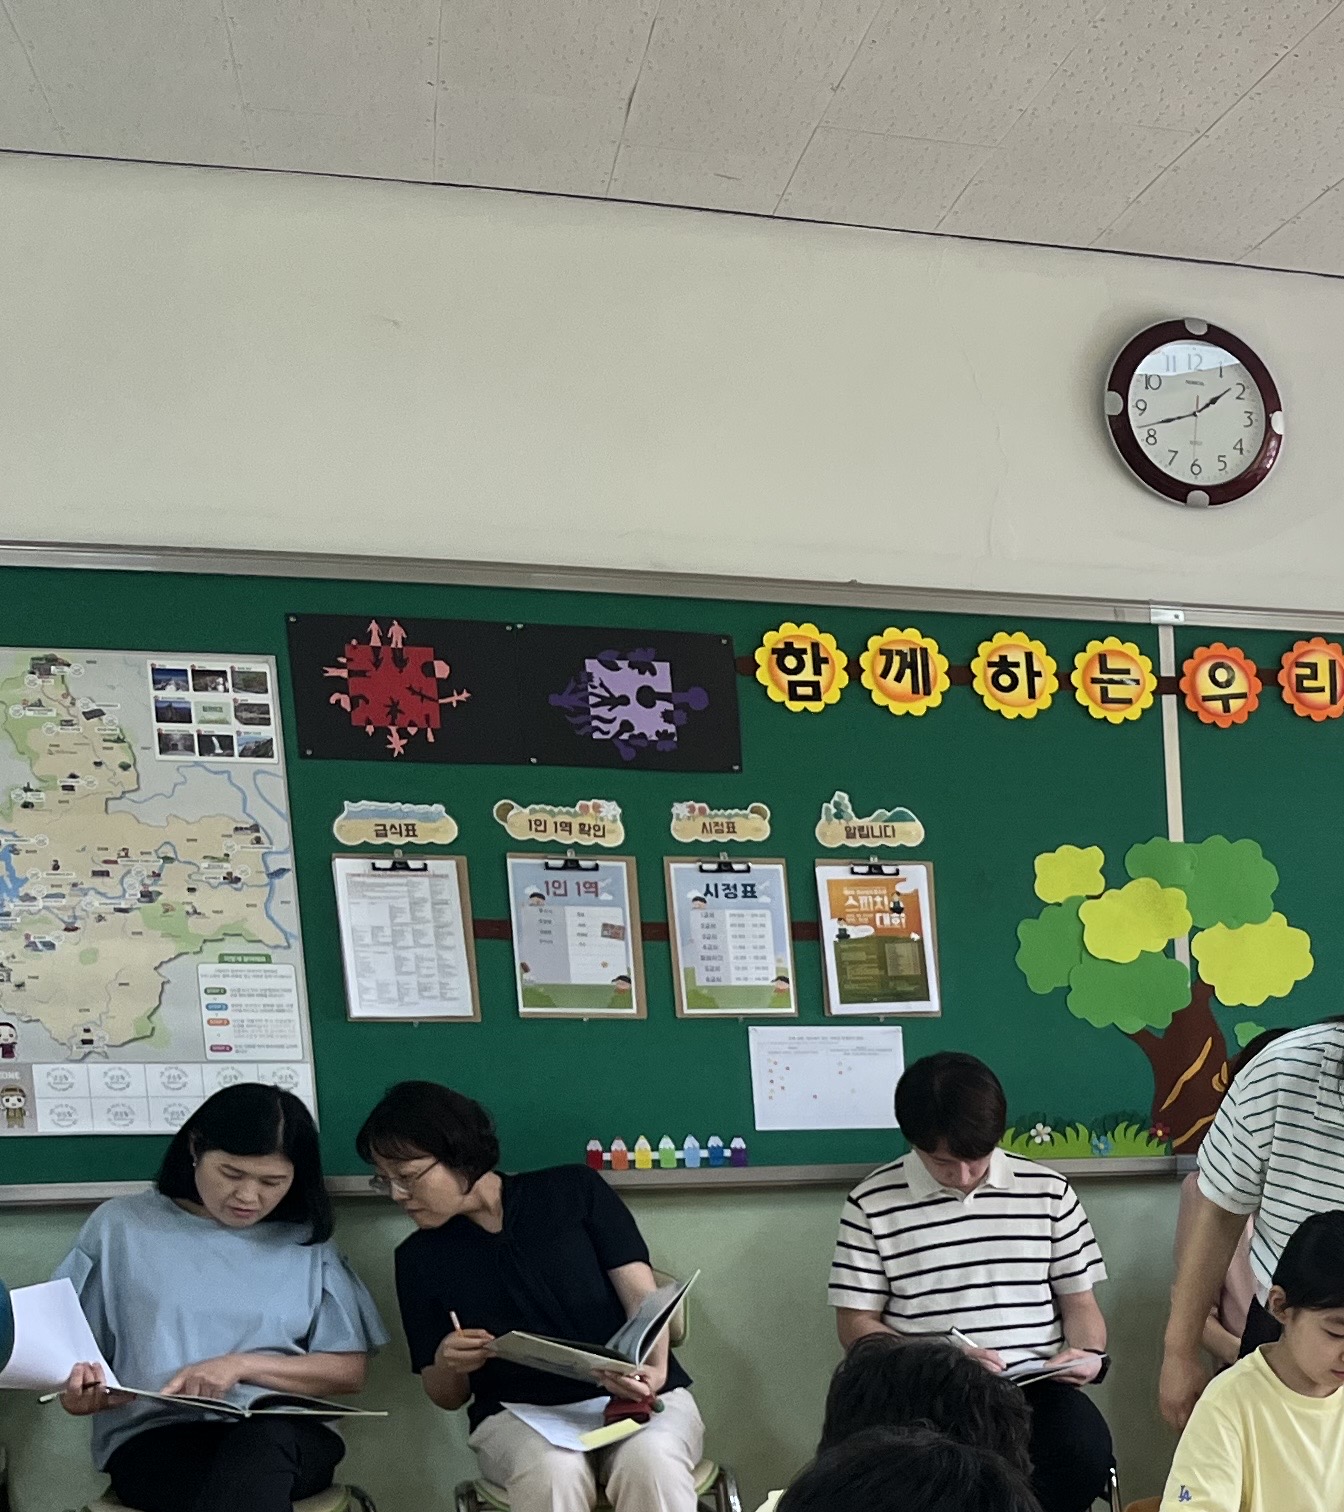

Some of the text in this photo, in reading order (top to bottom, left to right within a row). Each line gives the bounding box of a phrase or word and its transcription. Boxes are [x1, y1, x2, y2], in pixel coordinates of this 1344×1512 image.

[1165, 355, 1177, 373] 11
[1187, 353, 1203, 372] 12
[1218, 361, 1224, 379] 1
[1143, 374, 1162, 391] 10
[1235, 382, 1246, 401] 2
[1135, 399, 1147, 416] 9
[1243, 411, 1254, 428] 3
[1145, 428, 1157, 446] 8
[1233, 438, 1244, 455] 4
[1167, 449, 1178, 467] 7
[1190, 458, 1202, 476] 6
[1217, 454, 1227, 472] 5
[771, 640, 1338, 714] 함께하는 우리
[374, 822, 418, 838] 급식표
[528, 818, 606, 838] 1인 1역 확인
[701, 821, 737, 835] 시정표
[844, 825, 896, 839] 알립니다
[544, 879, 599, 898] 1인 1역
[703, 882, 758, 899] 시정표
[845, 895, 889, 912] 스피치
